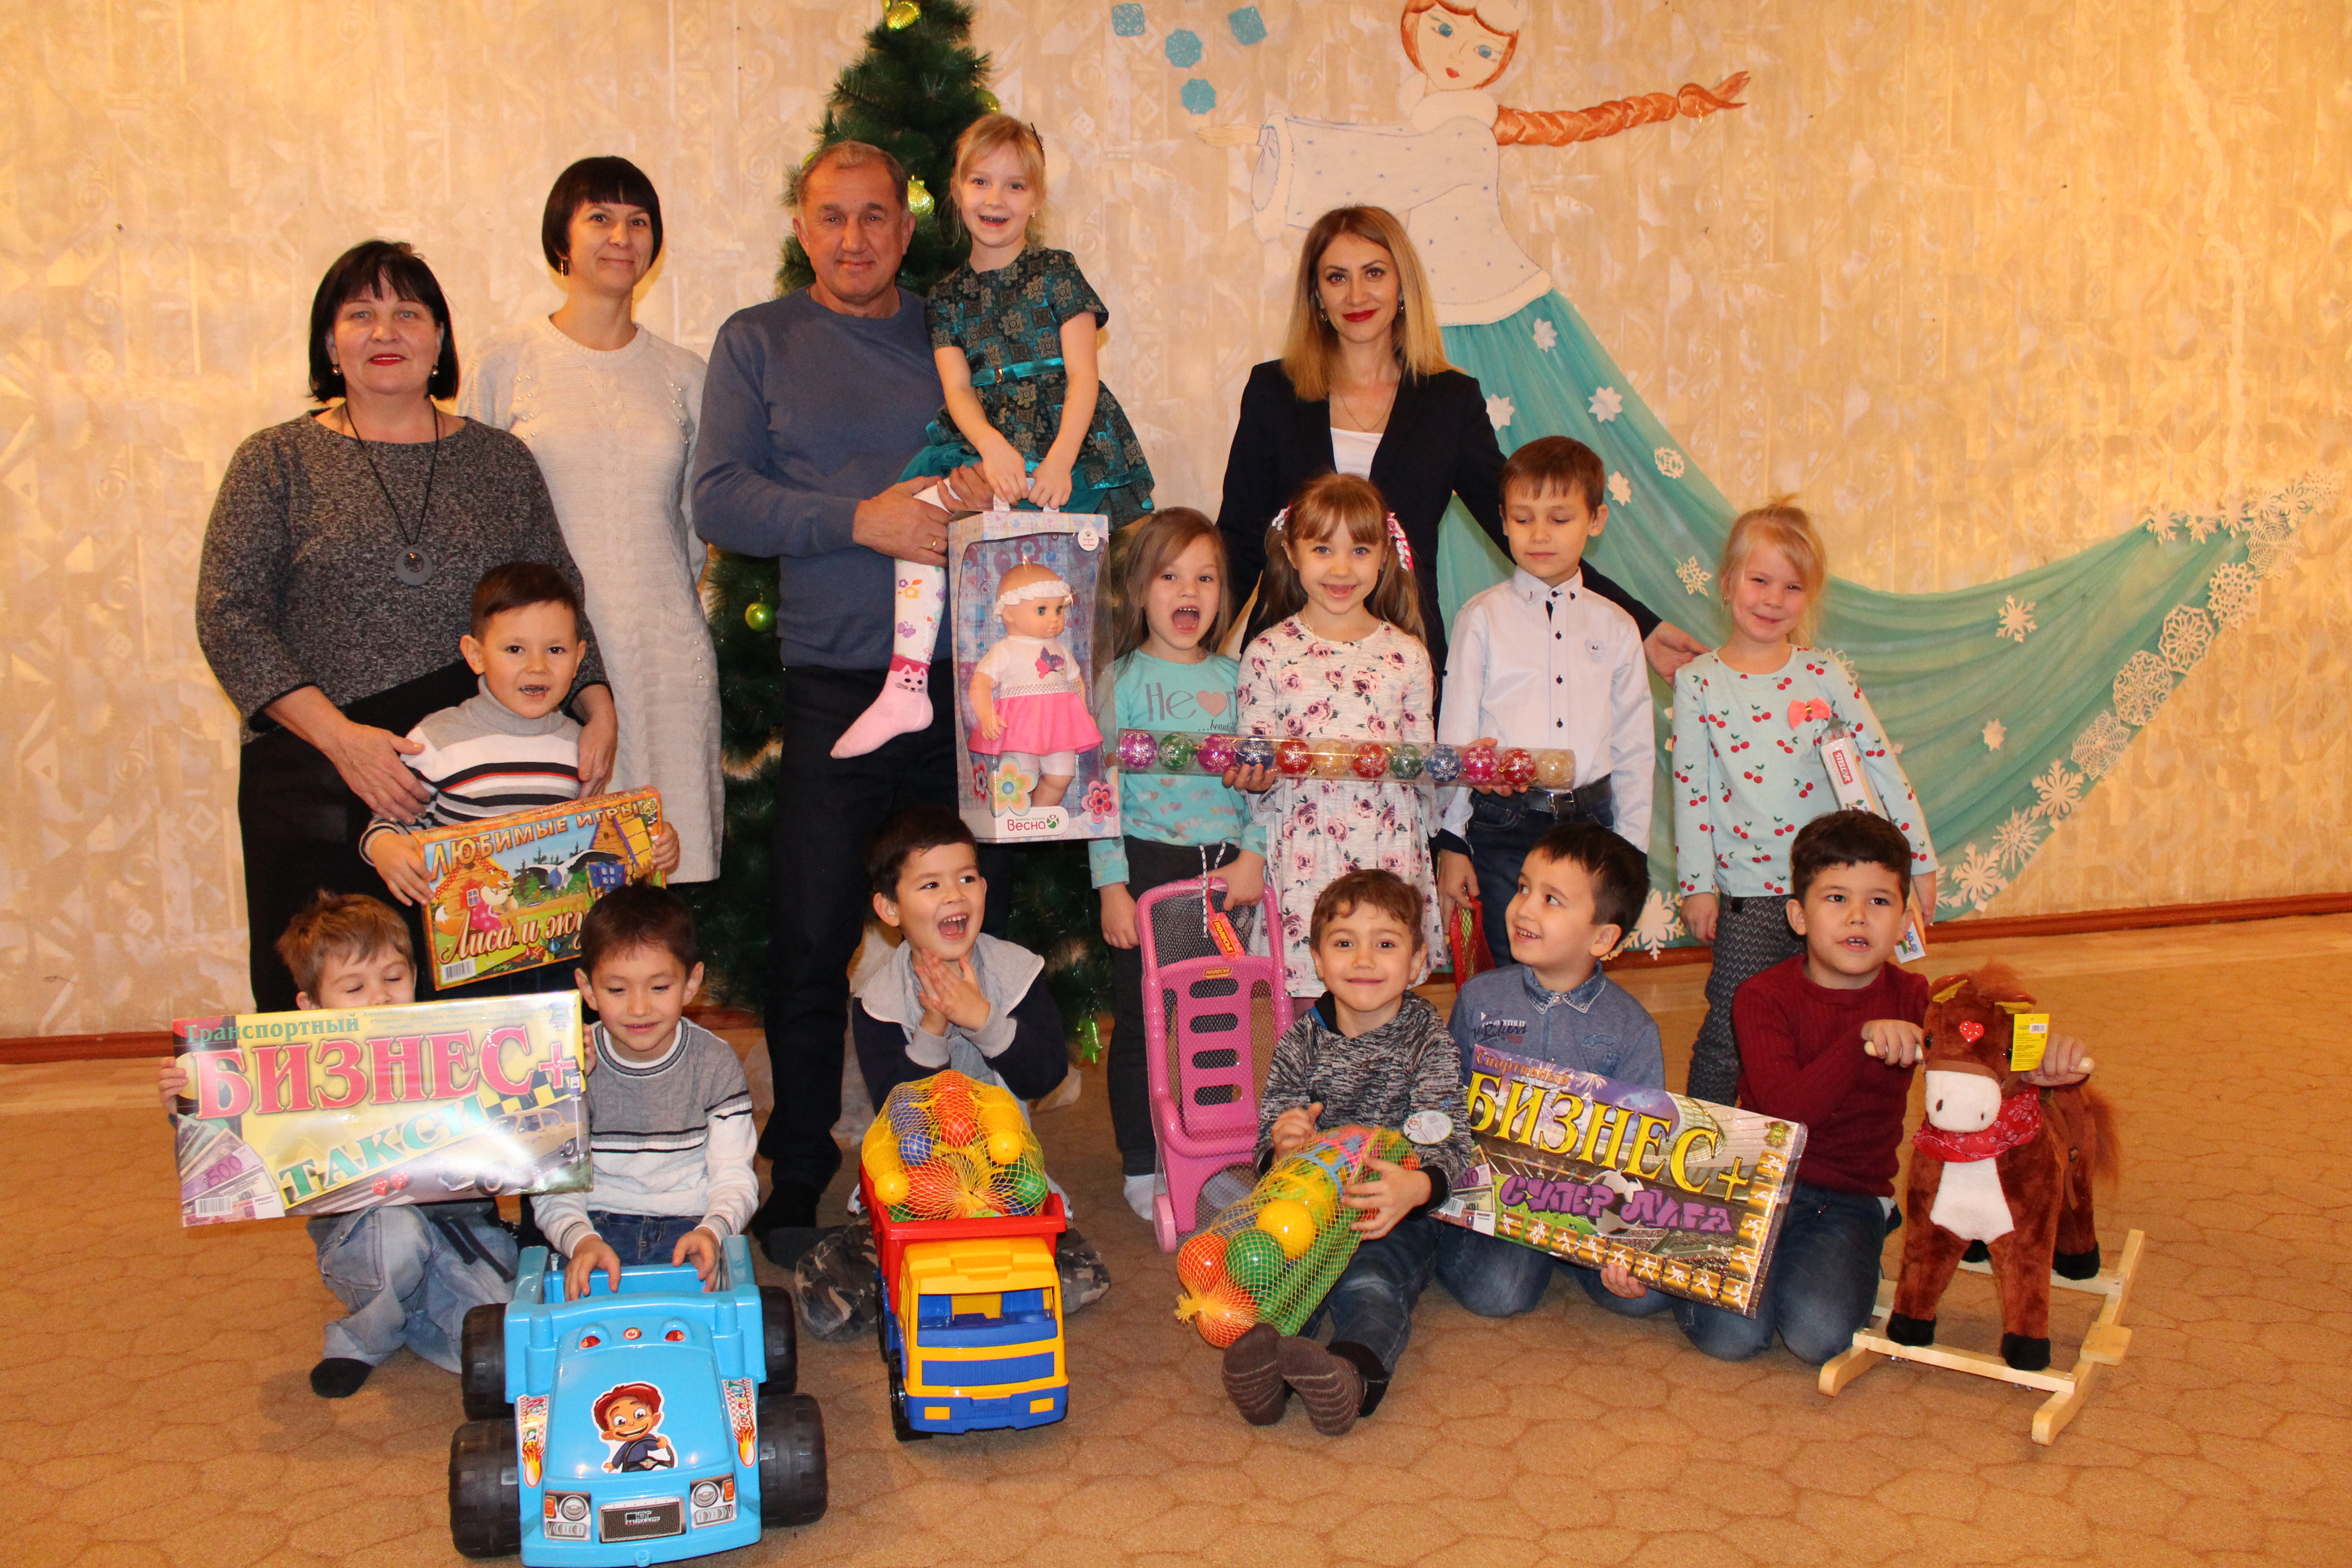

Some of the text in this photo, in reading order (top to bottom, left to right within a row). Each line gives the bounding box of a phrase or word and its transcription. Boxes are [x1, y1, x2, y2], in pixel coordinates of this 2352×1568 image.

[1835, 752, 1852, 782] STELLAR
[431, 801, 639, 882] ЛЮБИМЫЕ ИГРЫ
[1007, 819, 1046, 831] Весна
[437, 910, 515, 964] Лиса
[520, 919, 540, 945] и
[1214, 922, 1234, 951] ПОЛЕСЬЕ
[184, 1013, 360, 1048] Транспортный
[1476, 1051, 1570, 1086] Спортивный
[277, 1093, 489, 1202] ТАКСИ
[207, 1156, 242, 1187] 500
[1499, 1176, 1735, 1233] СУПЕР ЛИГА
